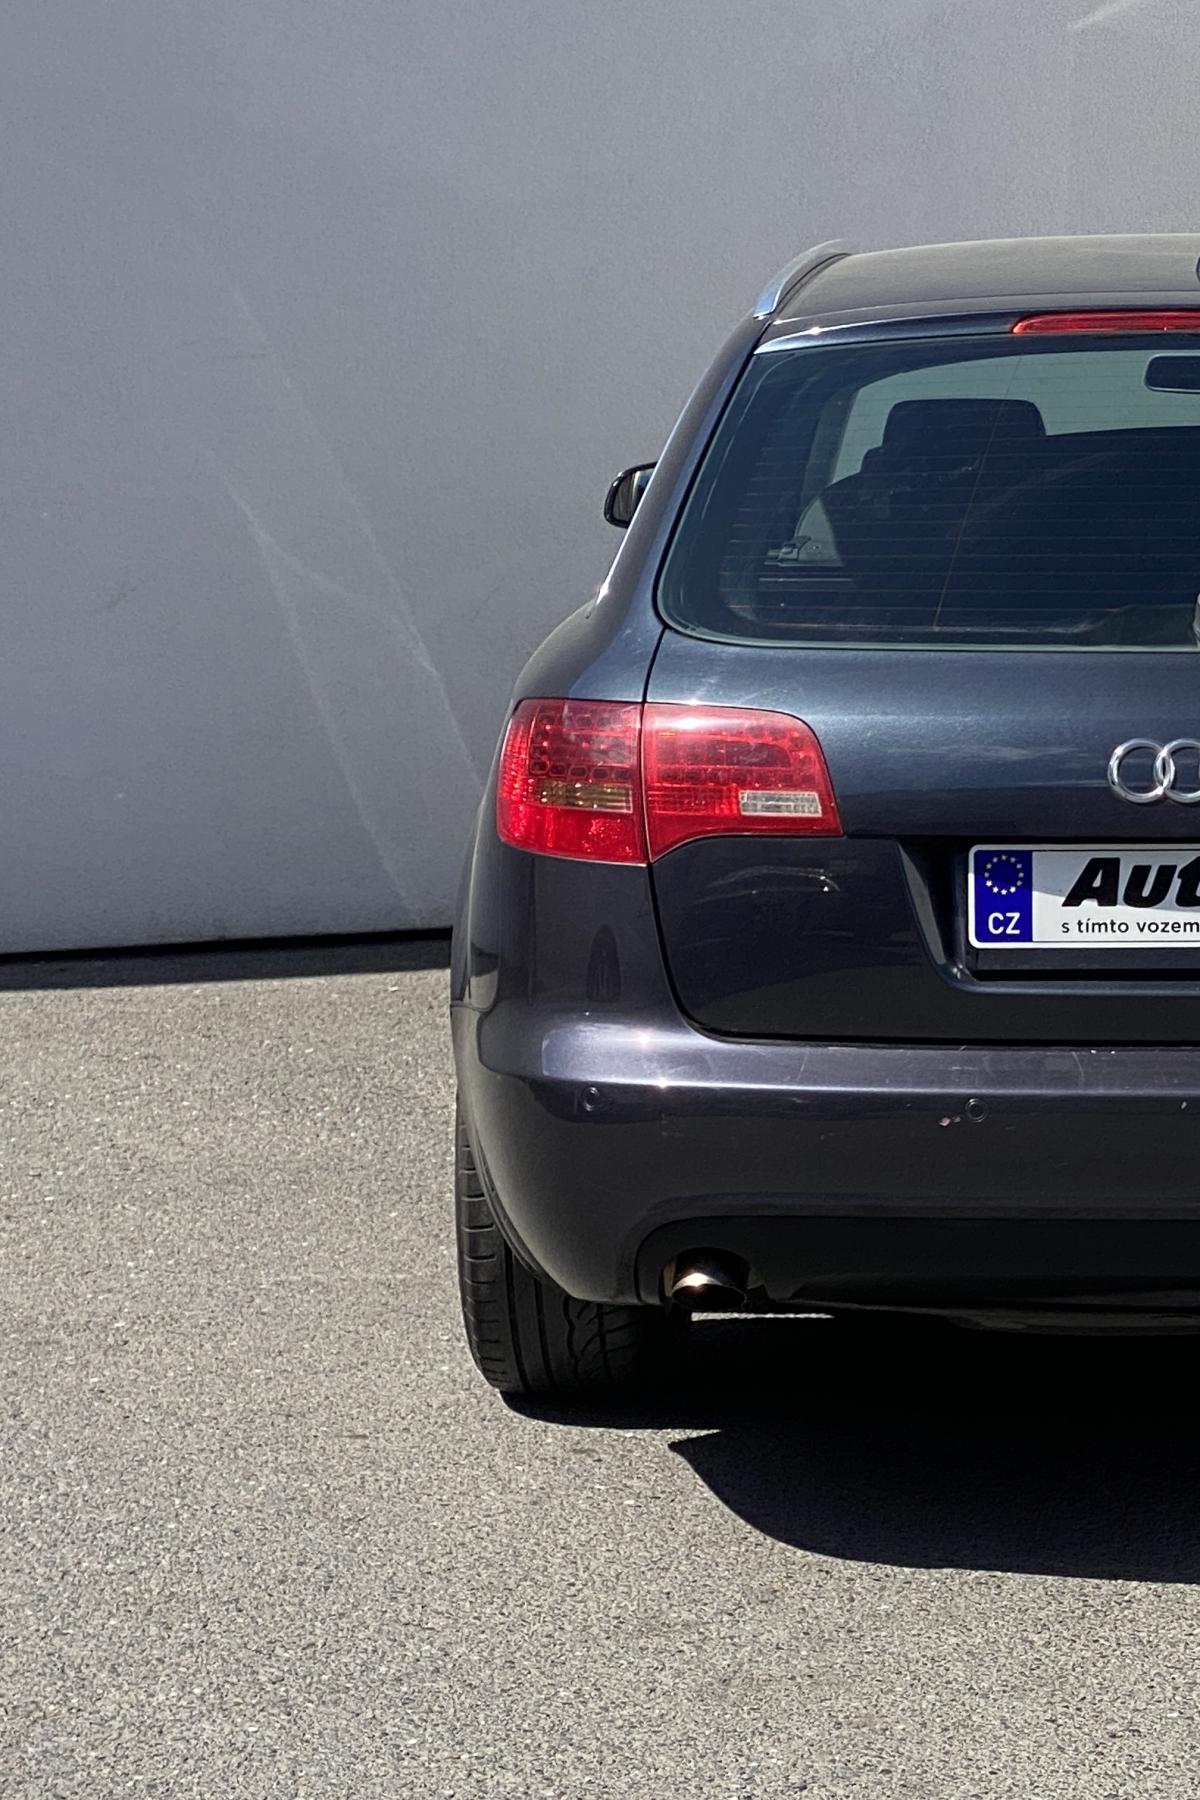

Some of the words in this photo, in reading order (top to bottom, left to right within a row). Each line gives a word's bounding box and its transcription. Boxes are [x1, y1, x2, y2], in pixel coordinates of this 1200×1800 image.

[988, 912, 1021, 935] CZ
[1061, 922, 1070, 933] s
[1077, 917, 1129, 934] tímto
[1136, 921, 1200, 934] vozem
